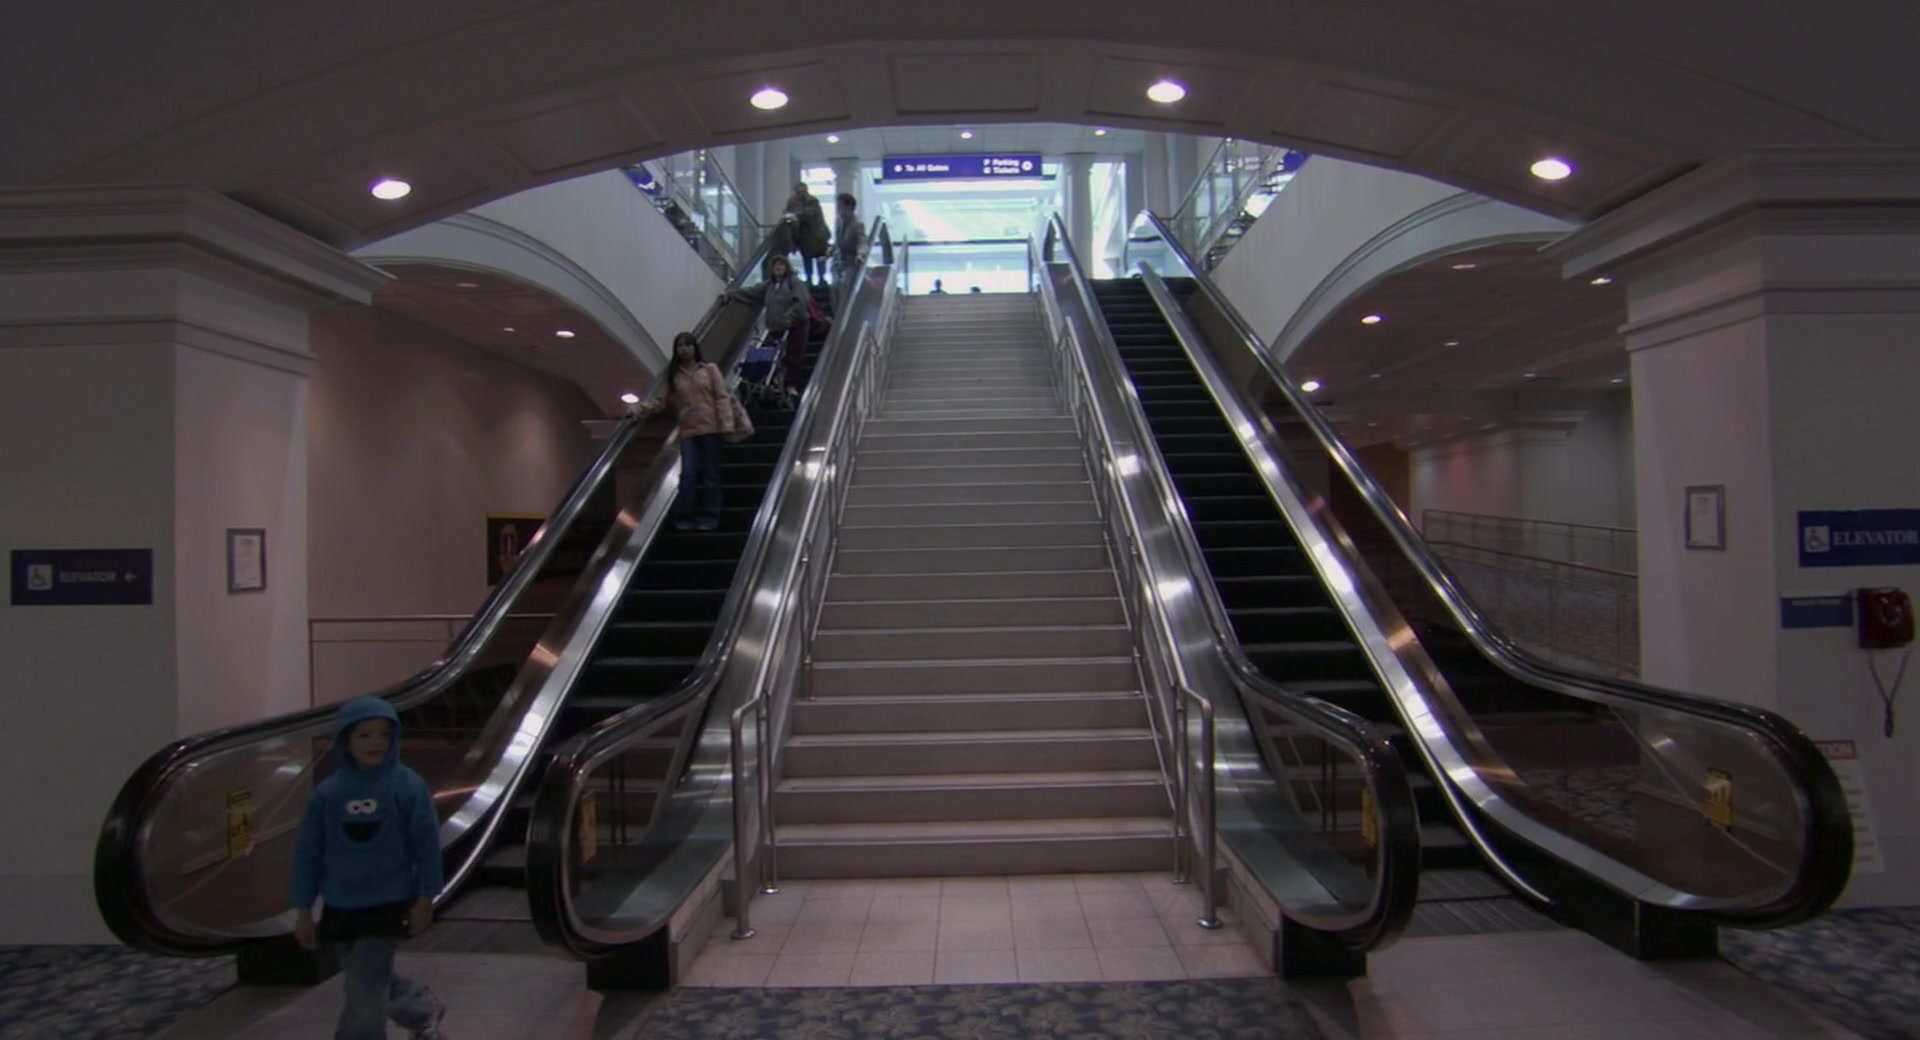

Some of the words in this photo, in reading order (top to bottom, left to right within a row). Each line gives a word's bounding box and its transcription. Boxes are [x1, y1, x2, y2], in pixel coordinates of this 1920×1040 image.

[904, 164, 915, 172] To
[916, 164, 926, 172] All
[927, 164, 950, 172] Gates
[992, 158, 1020, 167] Parking
[1833, 529, 1919, 546] ELEVATOR
[59, 570, 116, 583] ELEVATOR
